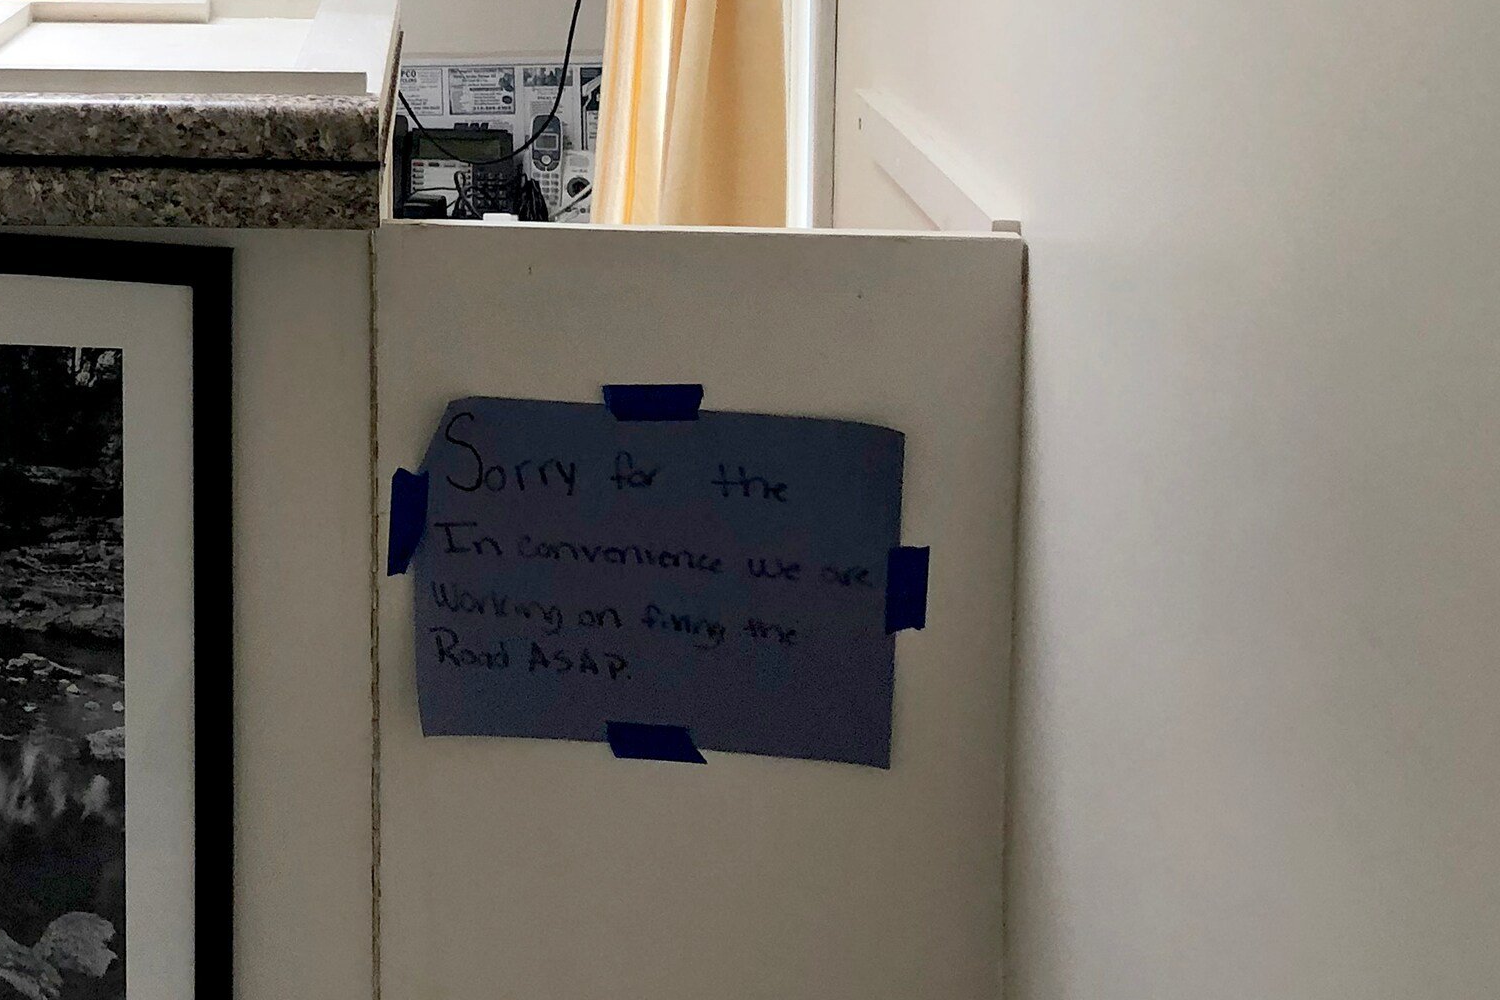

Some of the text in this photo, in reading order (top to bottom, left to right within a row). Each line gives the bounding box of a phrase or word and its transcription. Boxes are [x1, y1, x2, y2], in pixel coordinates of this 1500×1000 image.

[444, 412, 789, 504] Sorry for the
[578, 607, 622, 629] on
